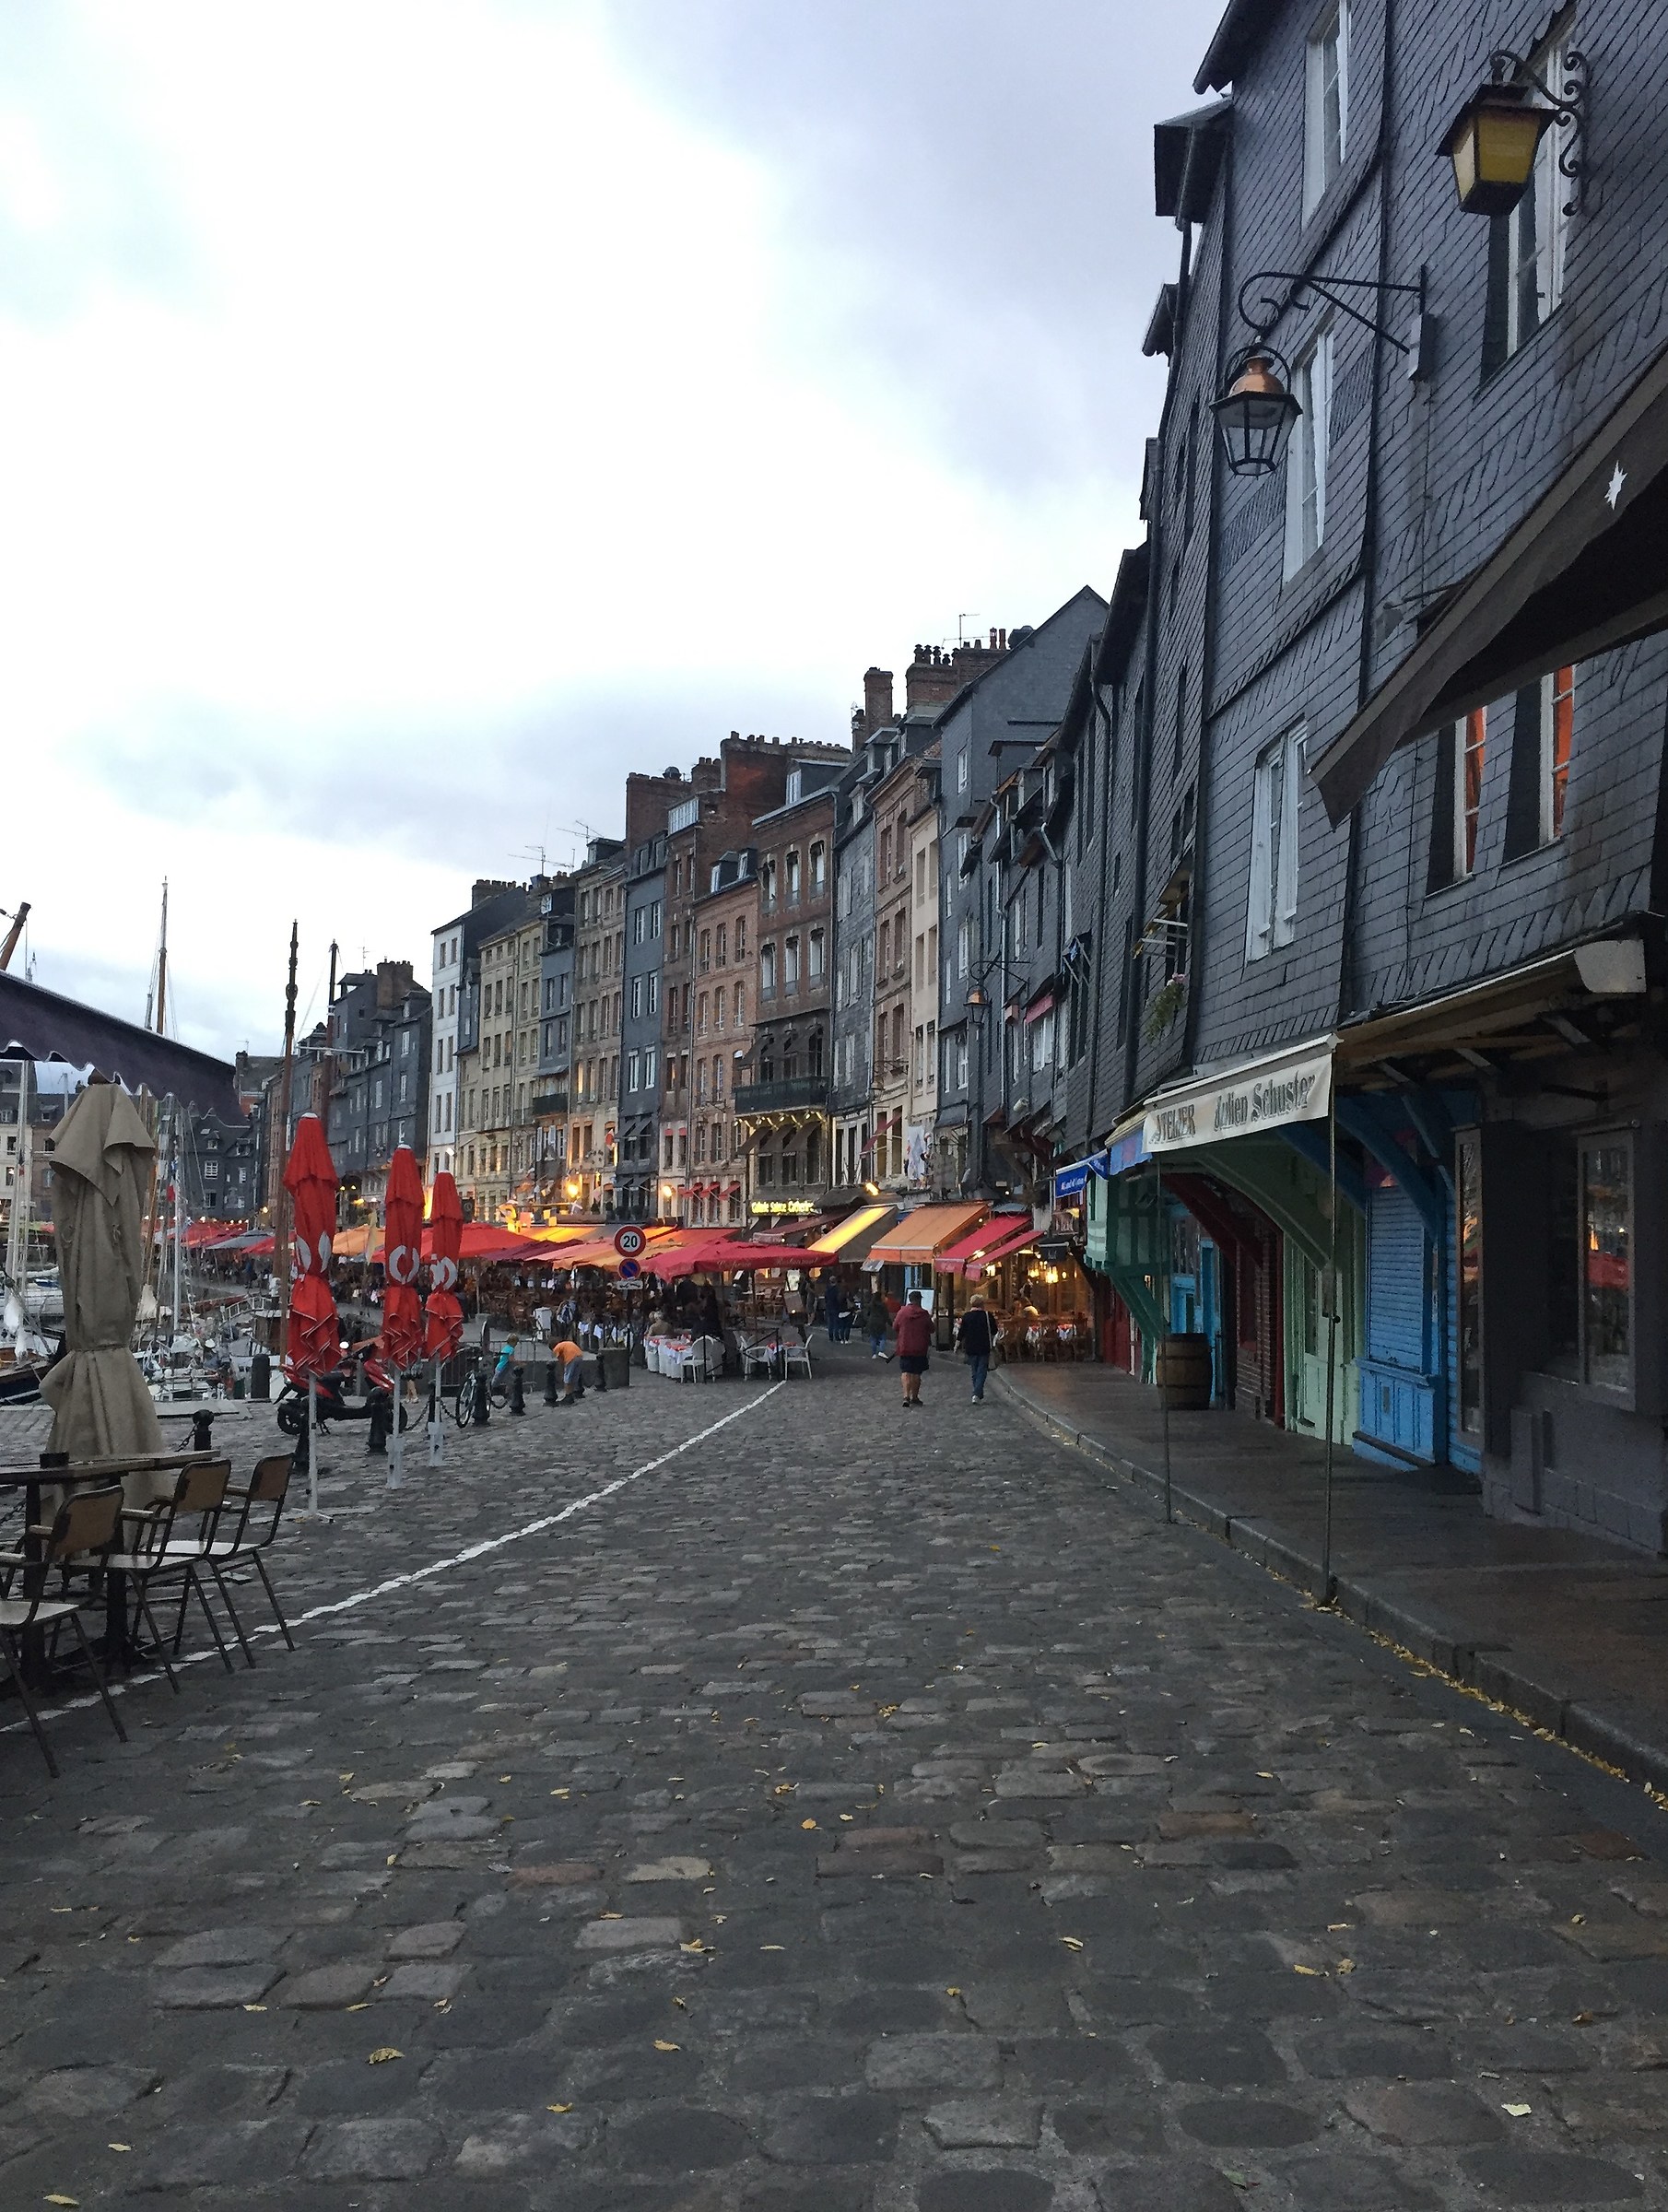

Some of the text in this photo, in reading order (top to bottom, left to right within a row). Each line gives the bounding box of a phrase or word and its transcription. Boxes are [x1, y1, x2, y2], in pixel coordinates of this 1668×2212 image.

[1149, 1070, 1316, 1143] ATELIER Julien Schuster
[623, 1235, 638, 1248] 20
